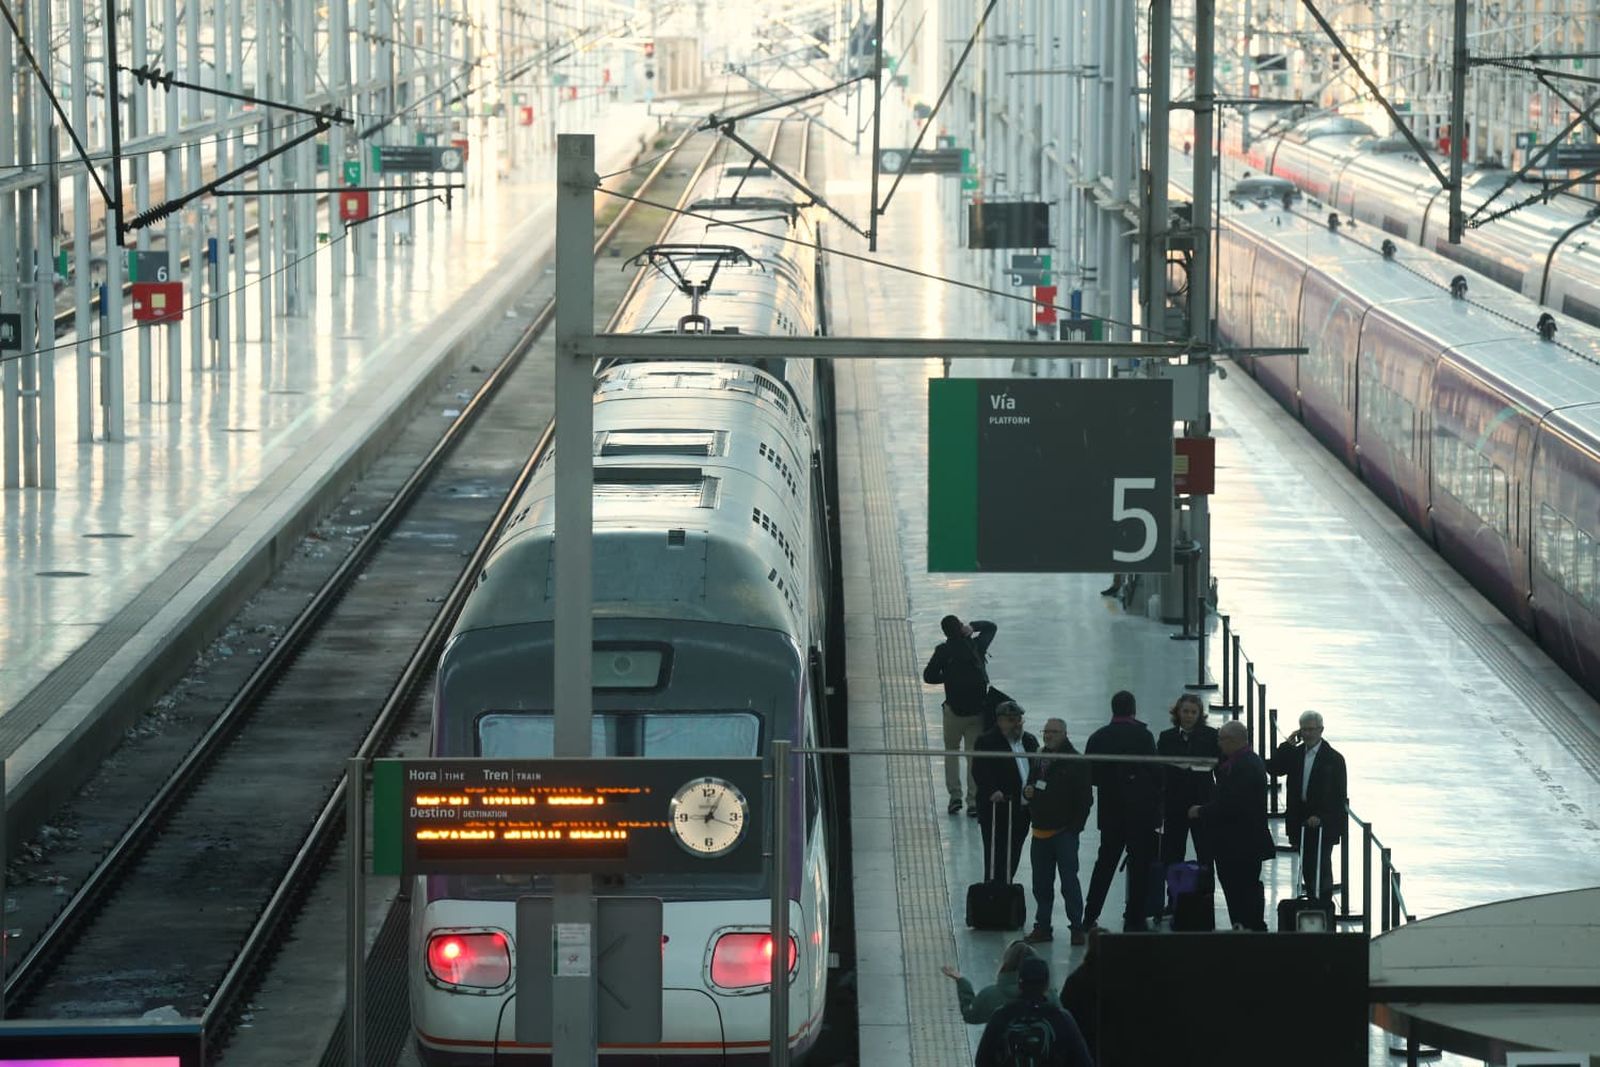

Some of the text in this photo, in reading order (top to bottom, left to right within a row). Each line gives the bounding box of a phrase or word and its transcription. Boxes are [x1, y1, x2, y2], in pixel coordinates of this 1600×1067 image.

[157, 266, 168, 282] 6
[990, 393, 1016, 410] Vía
[989, 416, 1031, 425] PLATFORM
[1113, 477, 1158, 563] 5
[409, 769, 542, 781] Hora TIME Tren TRAIN
[702, 788, 716, 798] 12
[410, 806, 508, 818] Destino DESTINATION
[680, 812, 738, 823] 9 3
[704, 837, 714, 847] 6
